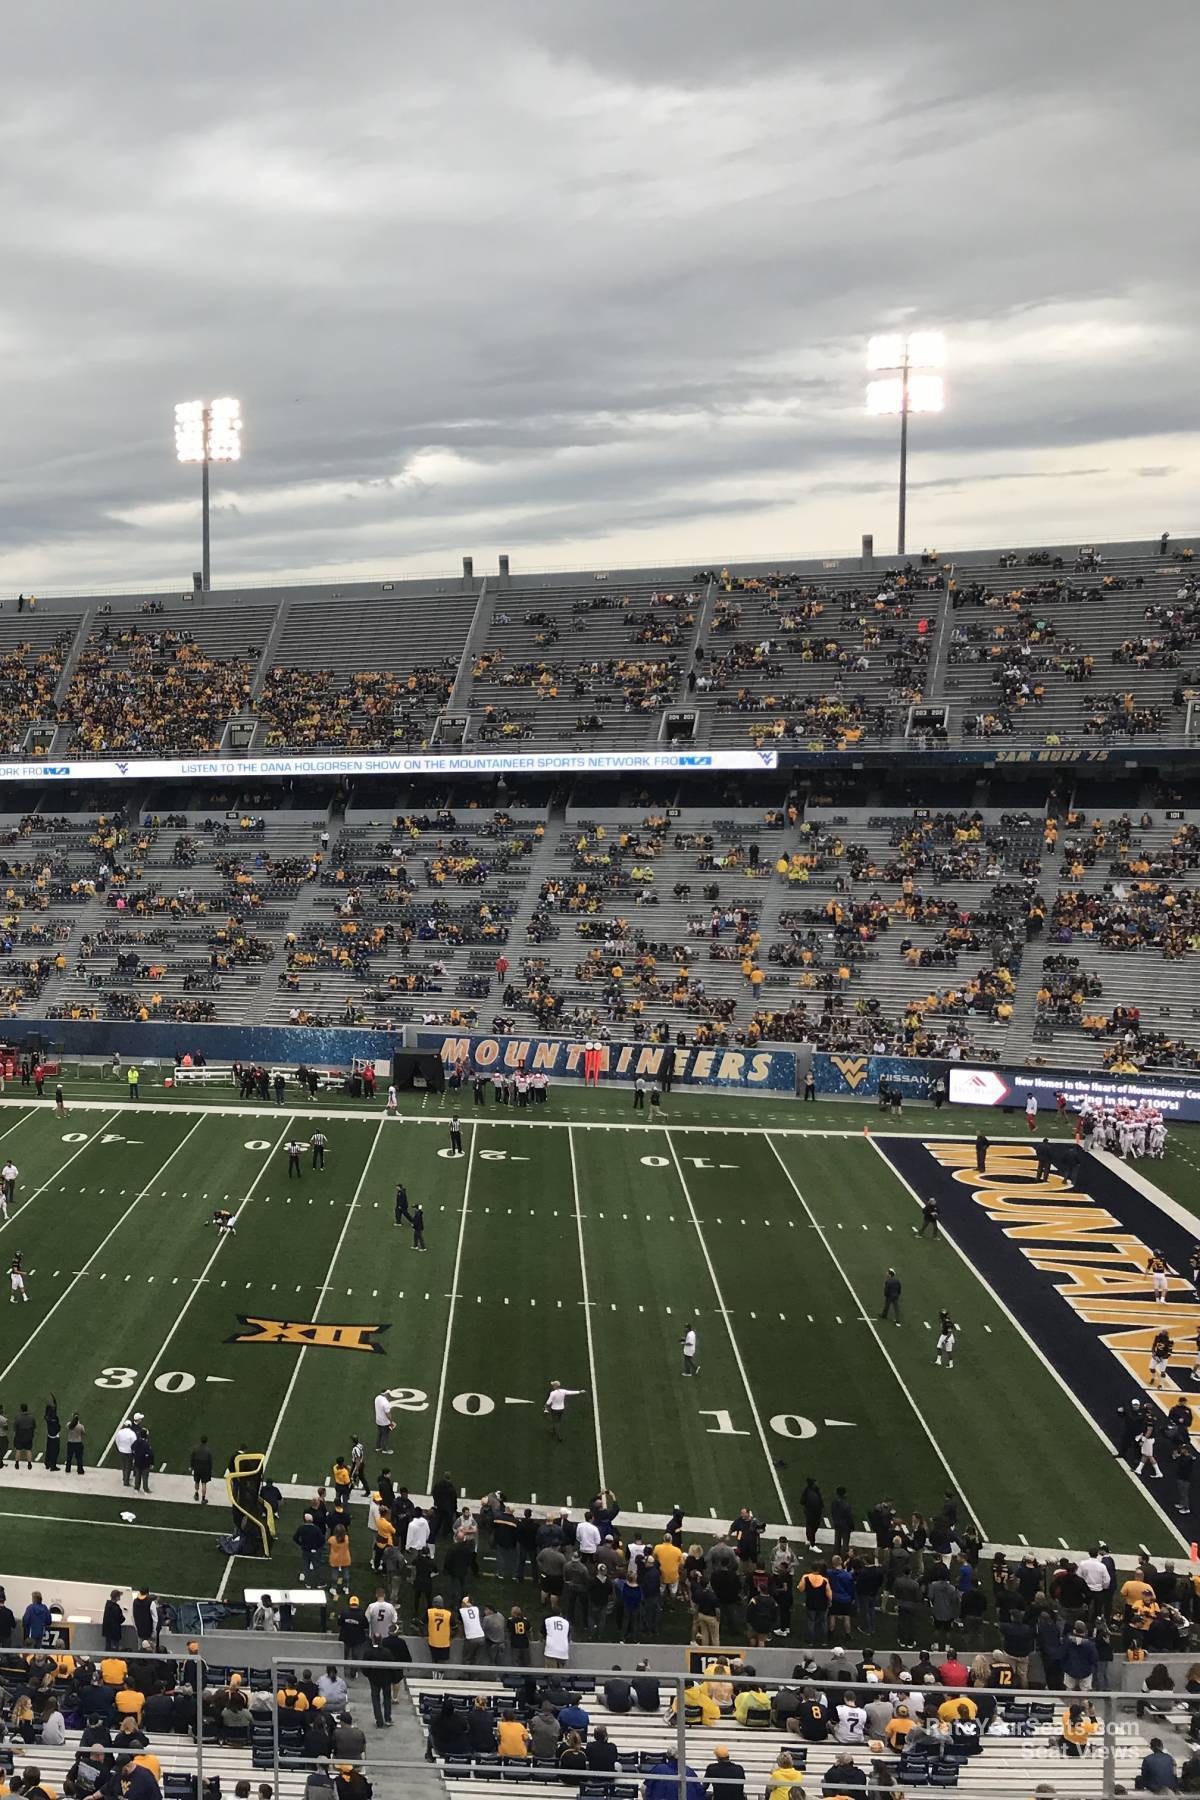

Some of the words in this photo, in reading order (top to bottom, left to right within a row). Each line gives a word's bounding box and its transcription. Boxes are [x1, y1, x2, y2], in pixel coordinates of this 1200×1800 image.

[995, 751, 1031, 762] SAM
[1039, 751, 1082, 761] HUFF
[1086, 750, 1109, 761] 75
[182, 764, 217, 773] LISTEN
[222, 764, 234, 772] TO
[238, 763, 257, 772] THE
[261, 763, 291, 772] DANA
[295, 761, 362, 771] HOLGORSEN
[365, 761, 400, 770] SHOW
[404, 760, 421, 769] ON
[424, 760, 445, 769] THE
[449, 759, 534, 768] MOUNTAINEER
[538, 758, 584, 767] SPORTS
[588, 757, 650, 766] NETWORK
[440, 1037, 773, 1082] MOUNTAINEERS
[880, 1073, 930, 1084] NISSAN
[1015, 1077, 1034, 1088] New
[1034, 1078, 1064, 1090] Homes
[1065, 1080, 1073, 1090] in
[1074, 1080, 1090, 1091] the
[1091, 1082, 1116, 1094] Heart
[1117, 1084, 1128, 1094] of
[1128, 1085, 1185, 1099] Mountaineer
[1062, 1093, 1103, 1107] tarting
[1105, 1095, 1114, 1106] in
[1115, 1096, 1137, 1107] the
[94, 1367, 196, 1393] 30
[387, 1387, 496, 1417] 20
[698, 1409, 818, 1439] 10
[377, 1609, 385, 1622] 5
[467, 1608, 476, 1620] 8
[434, 1618, 444, 1632] 7
[514, 1621, 525, 1635] 18
[553, 1620, 563, 1631] 16
[999, 1670, 1012, 1685] 12
[811, 1707, 822, 1719] 8
[847, 1718, 859, 1733] 7
